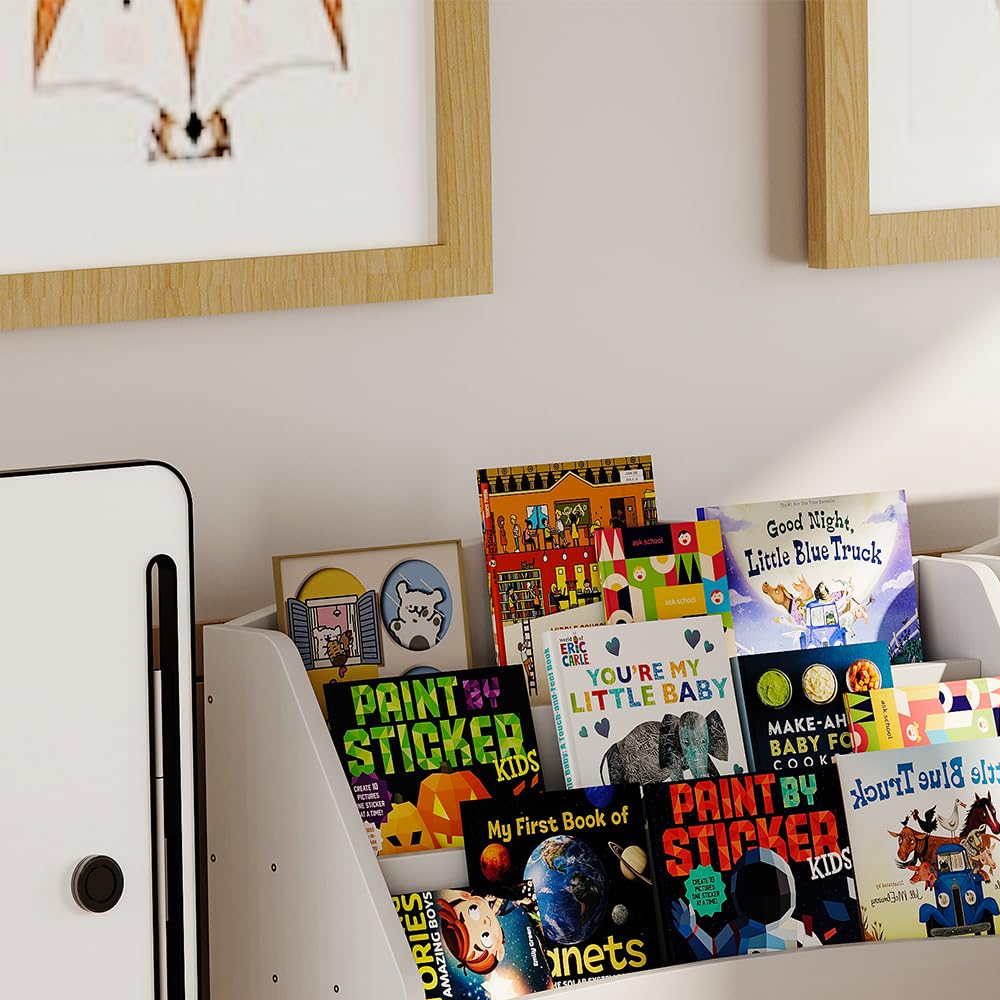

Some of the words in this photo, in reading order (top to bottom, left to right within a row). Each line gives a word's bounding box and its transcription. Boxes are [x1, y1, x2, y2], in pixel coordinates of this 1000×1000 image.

[767, 512, 804, 538] Good
[808, 510, 854, 534] Night,
[744, 547, 790, 577] Little
[793, 540, 829, 566] Blue
[830, 535, 882, 564] Truck
[562, 654, 590, 668] CARLE
[586, 662, 665, 686] YOU'RE
[670, 659, 699, 678] MY
[350, 676, 458, 726] PAINT
[462, 676, 500, 710] BY
[570, 685, 656, 714] LITTLE
[662, 678, 727, 704] BABY
[768, 713, 846, 736] MAKE-AH
[881, 700, 894, 740] ask.school
[344, 712, 526, 777] STICKER
[770, 735, 820, 757] BABY
[828, 732, 853, 750] FO
[773, 754, 828, 770] COOK
[492, 749, 540, 782] KIDS
[669, 773, 776, 824] PAINT
[780, 774, 818, 808] BY
[488, 820, 512, 842] My
[516, 816, 559, 836] First
[562, 808, 606, 831] Book
[611, 806, 629, 826] of
[662, 810, 842, 878] STICKER
[807, 846, 852, 880] KIDS
[422, 892, 438, 929] BOYS
[526, 926, 535, 946] Green
[430, 932, 454, 998] AMAZING
[530, 946, 538, 967] Emily
[547, 936, 648, 978] anets
